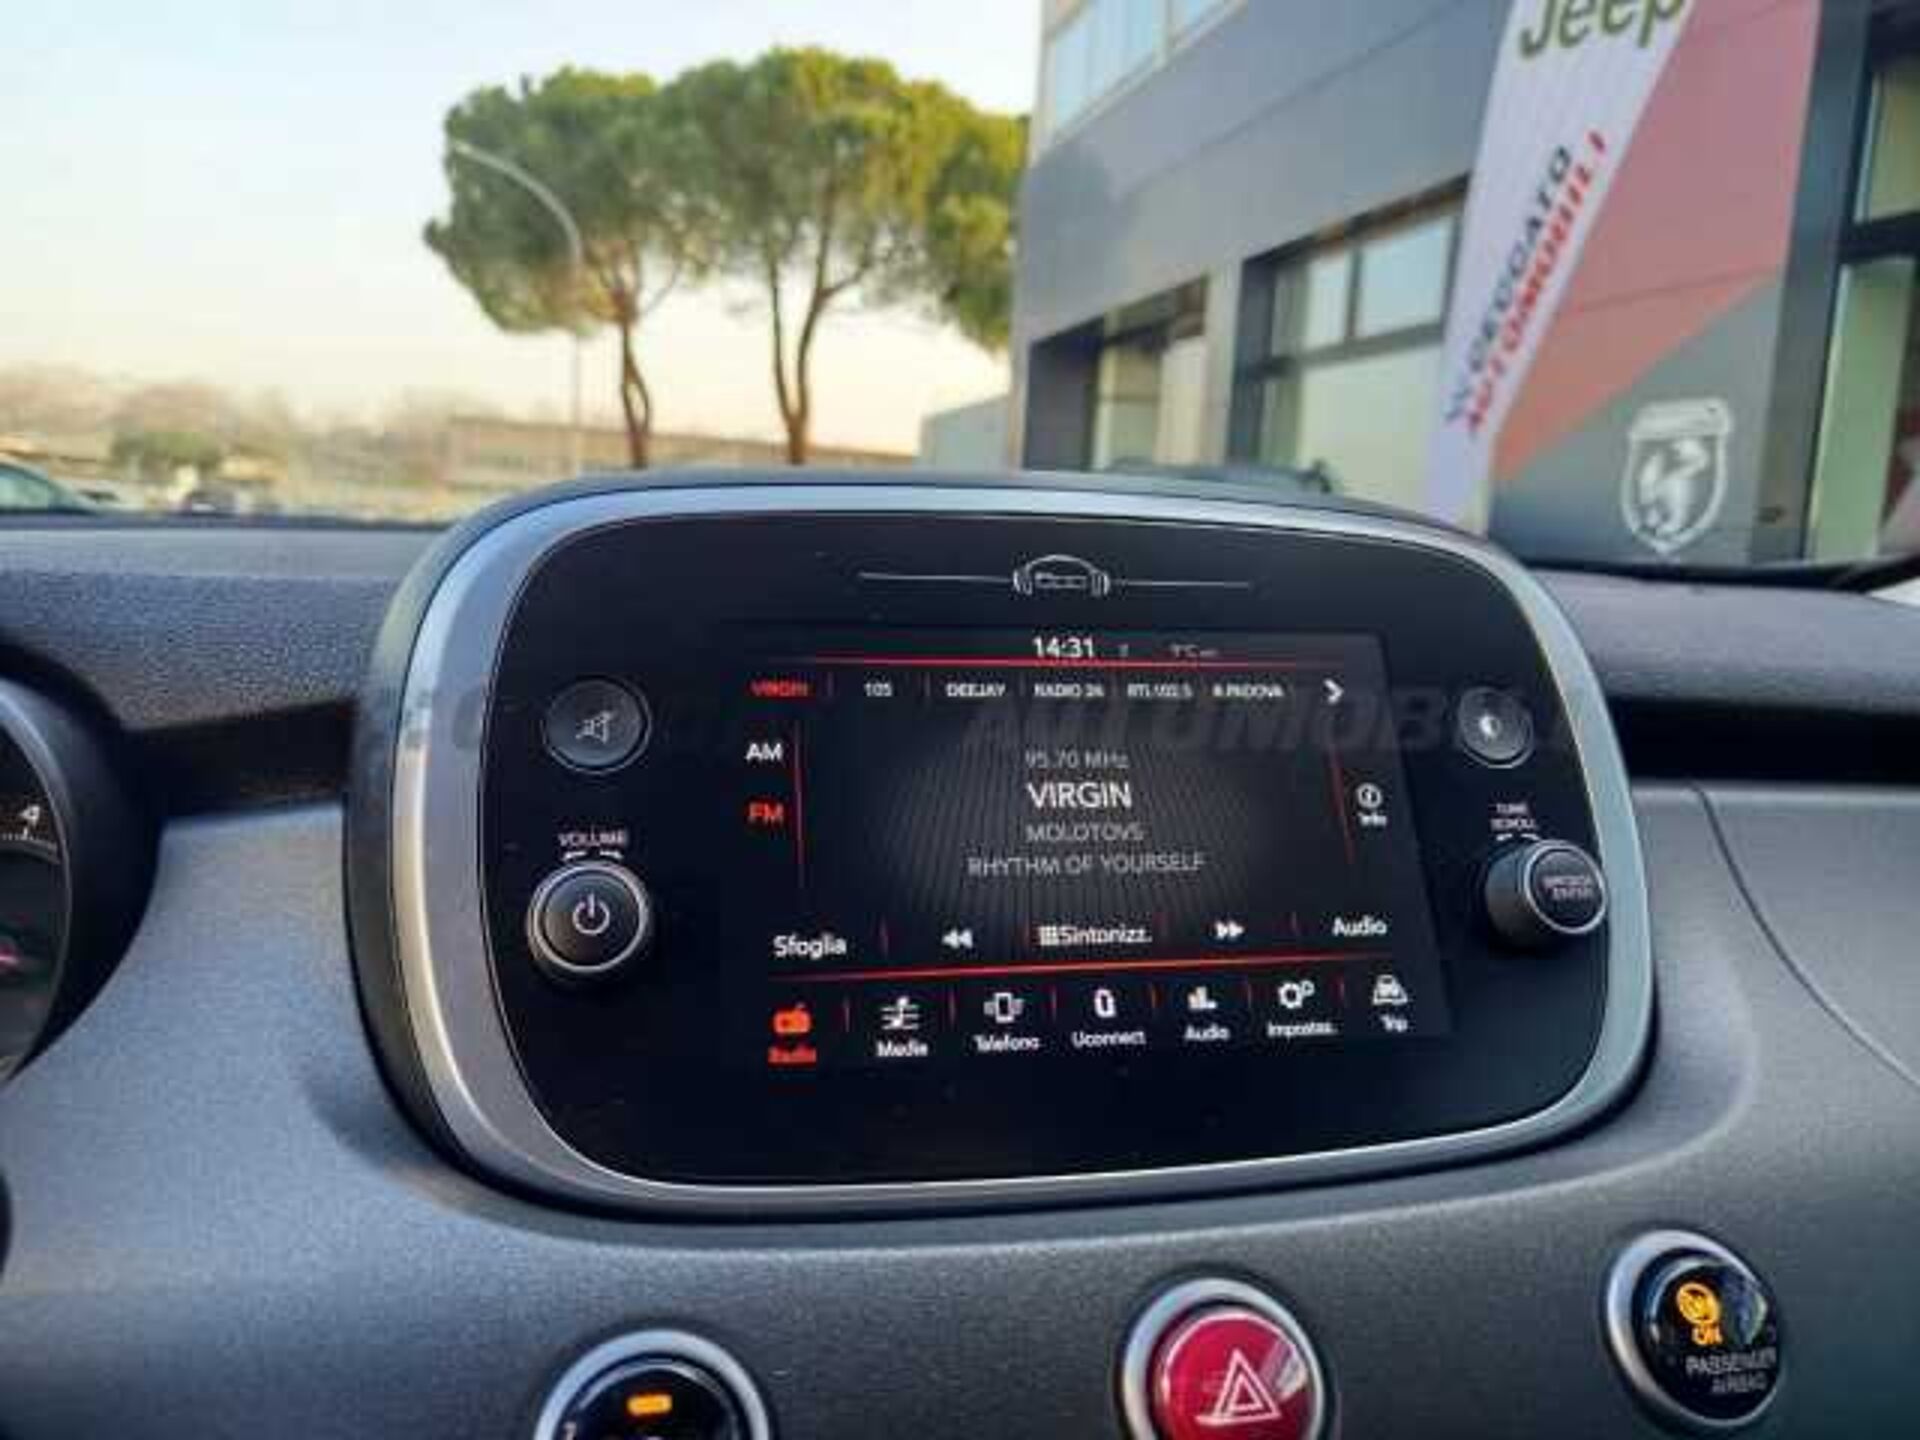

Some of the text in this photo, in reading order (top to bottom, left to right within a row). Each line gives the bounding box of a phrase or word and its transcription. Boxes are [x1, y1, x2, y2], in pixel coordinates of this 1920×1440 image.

[1519, 0, 1685, 59] Jeep
[1032, 636, 1095, 659] 14:31
[863, 682, 893, 698] 105
[945, 682, 1006, 698] DEEJAY
[1033, 683, 1081, 698] RADIO
[746, 743, 783, 762] AM
[1026, 781, 1133, 809] VIRGIN
[749, 803, 783, 823] FM
[967, 852, 1207, 876] RHYTHM OF YOURSELF
[1332, 914, 1388, 937] Audio
[772, 932, 848, 961] Sfoglia
[1184, 1024, 1231, 1042] Audio
